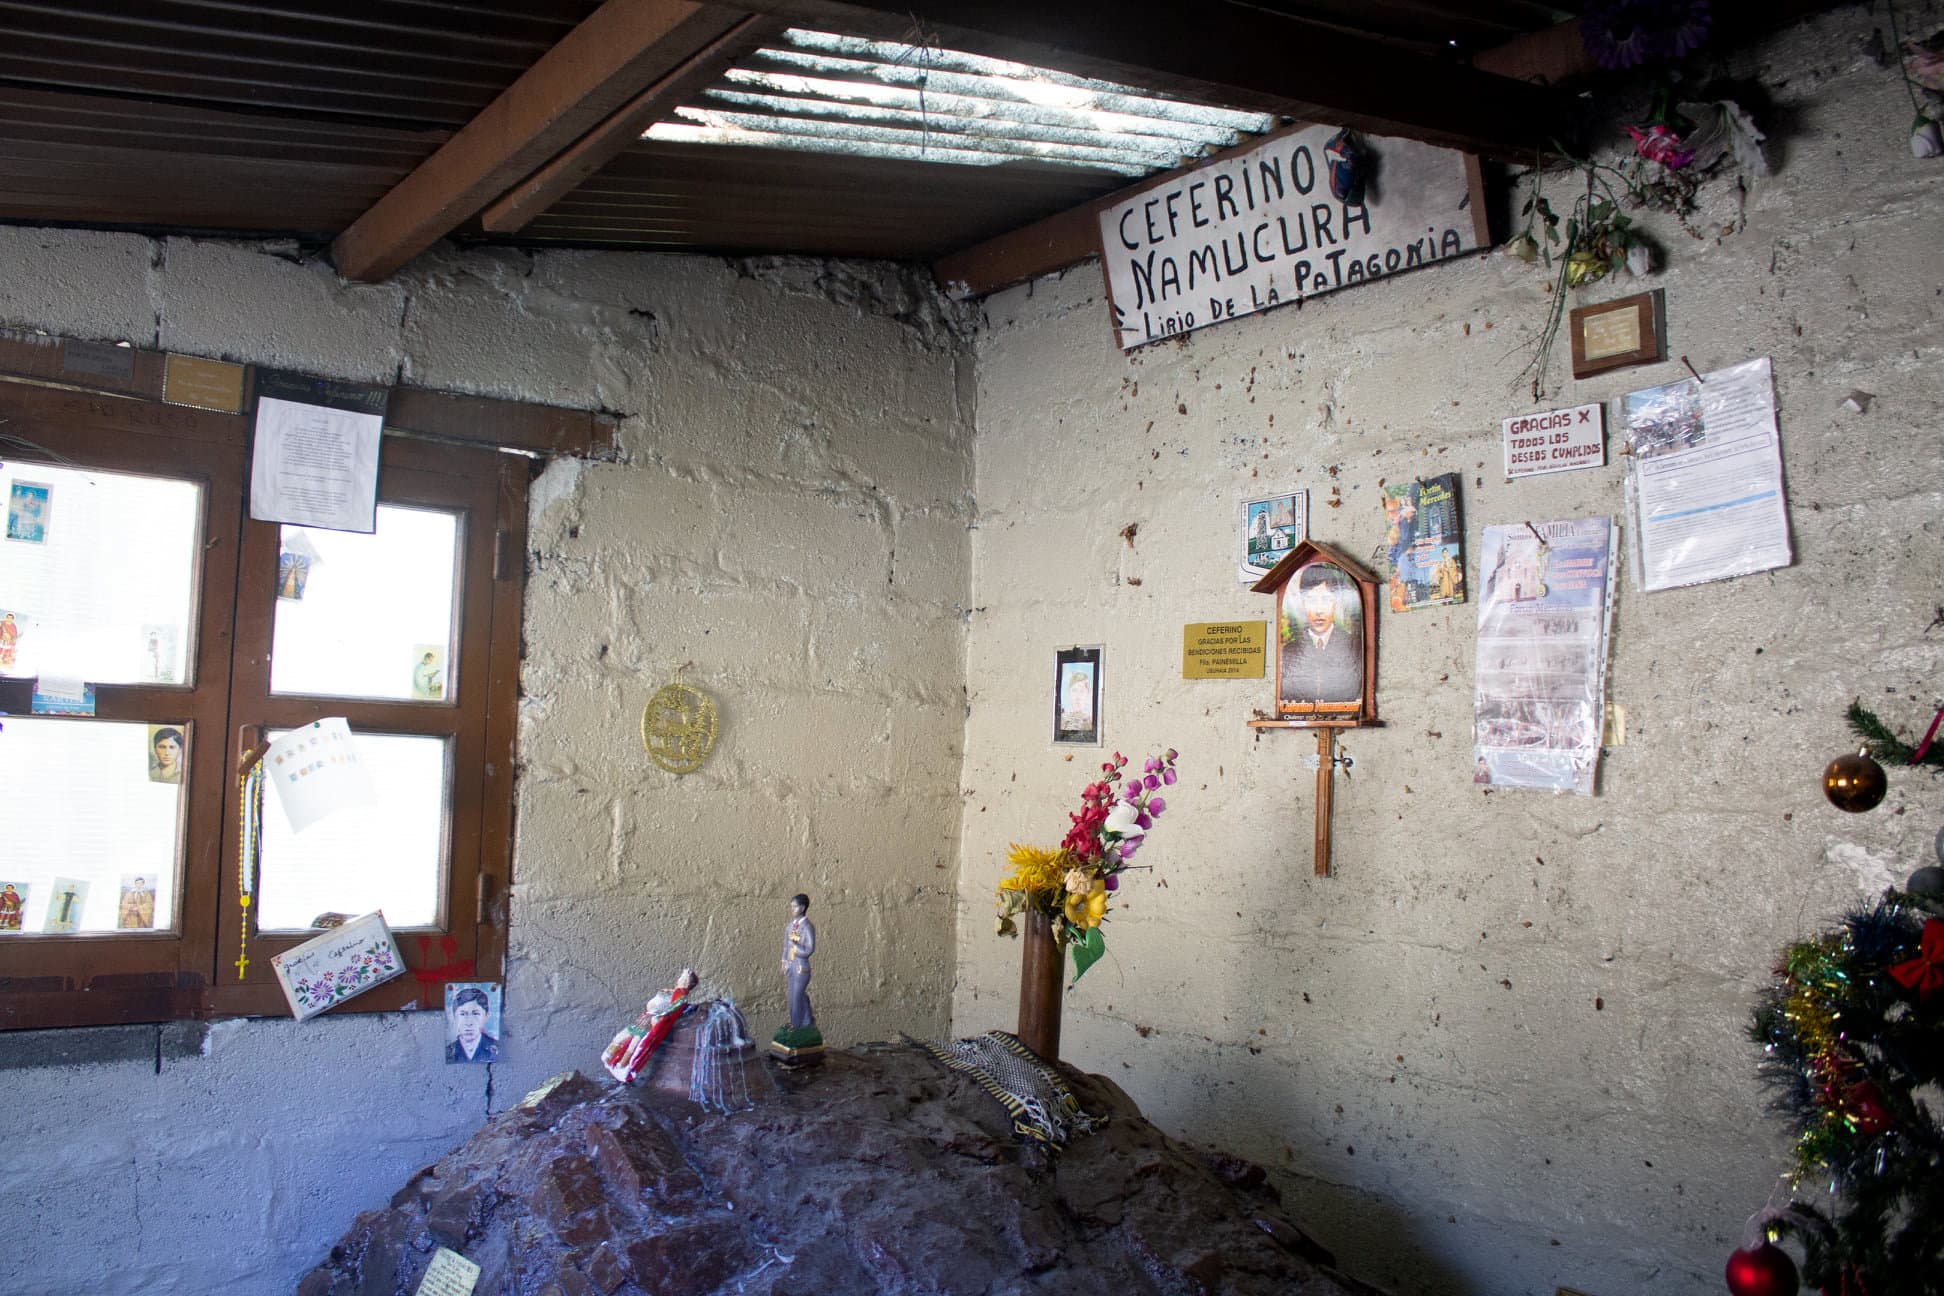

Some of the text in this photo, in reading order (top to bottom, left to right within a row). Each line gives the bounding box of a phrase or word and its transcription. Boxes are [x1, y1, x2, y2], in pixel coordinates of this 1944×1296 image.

[1120, 145, 1315, 250] CEFERINO
[1131, 202, 1371, 310] NAMUCURA
[1210, 297, 1235, 319] DE
[1250, 285, 1280, 307] LA
[1510, 413, 1571, 435] GRACIAS
[1511, 432, 1569, 448] TODOS LOS
[1511, 443, 1600, 463] DESEOS CUMPLIDOS
[1207, 626, 1243, 634] CEFERINO
[1198, 637, 1224, 645] GRACIAS
